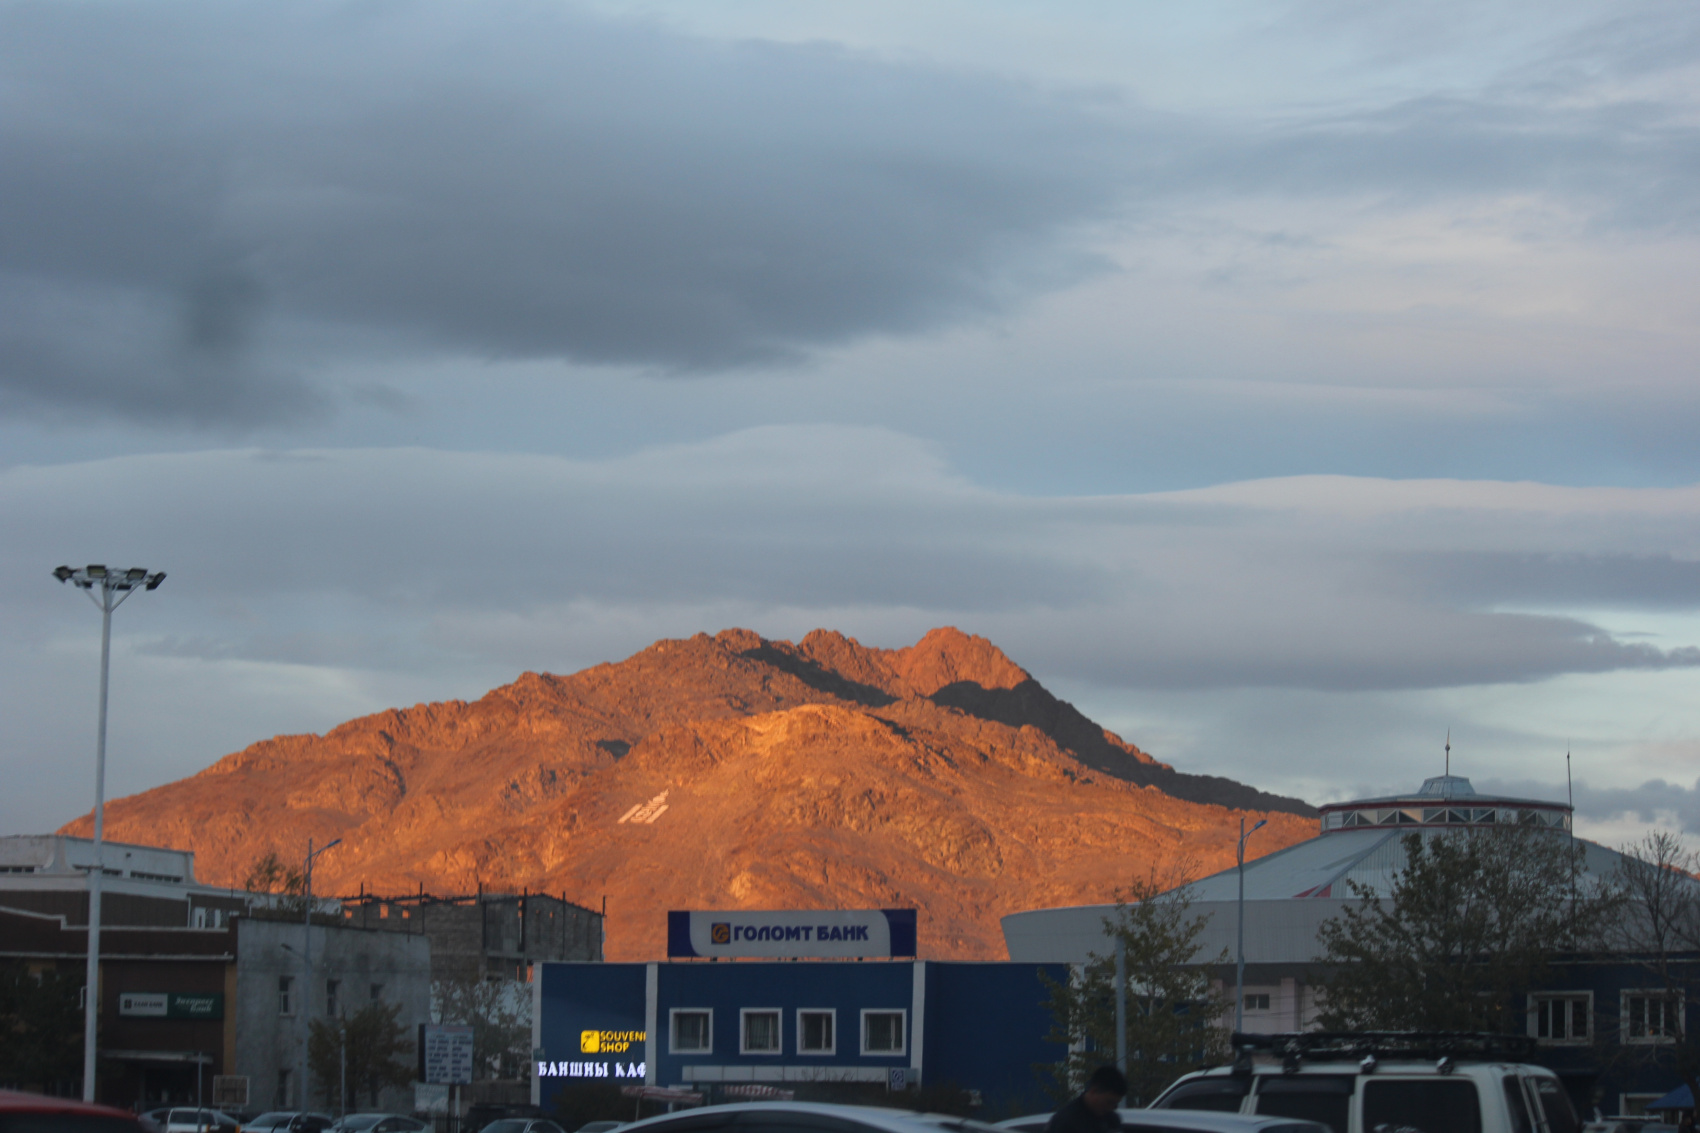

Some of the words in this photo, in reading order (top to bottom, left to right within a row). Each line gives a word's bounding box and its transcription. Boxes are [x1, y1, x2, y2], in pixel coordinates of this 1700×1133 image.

[733, 925, 813, 941] ГОЛОМТ
[817, 925, 868, 941] БАНК
[600, 1041, 630, 1053] SHOP
[538, 1061, 608, 1077] БАНШНЫ
